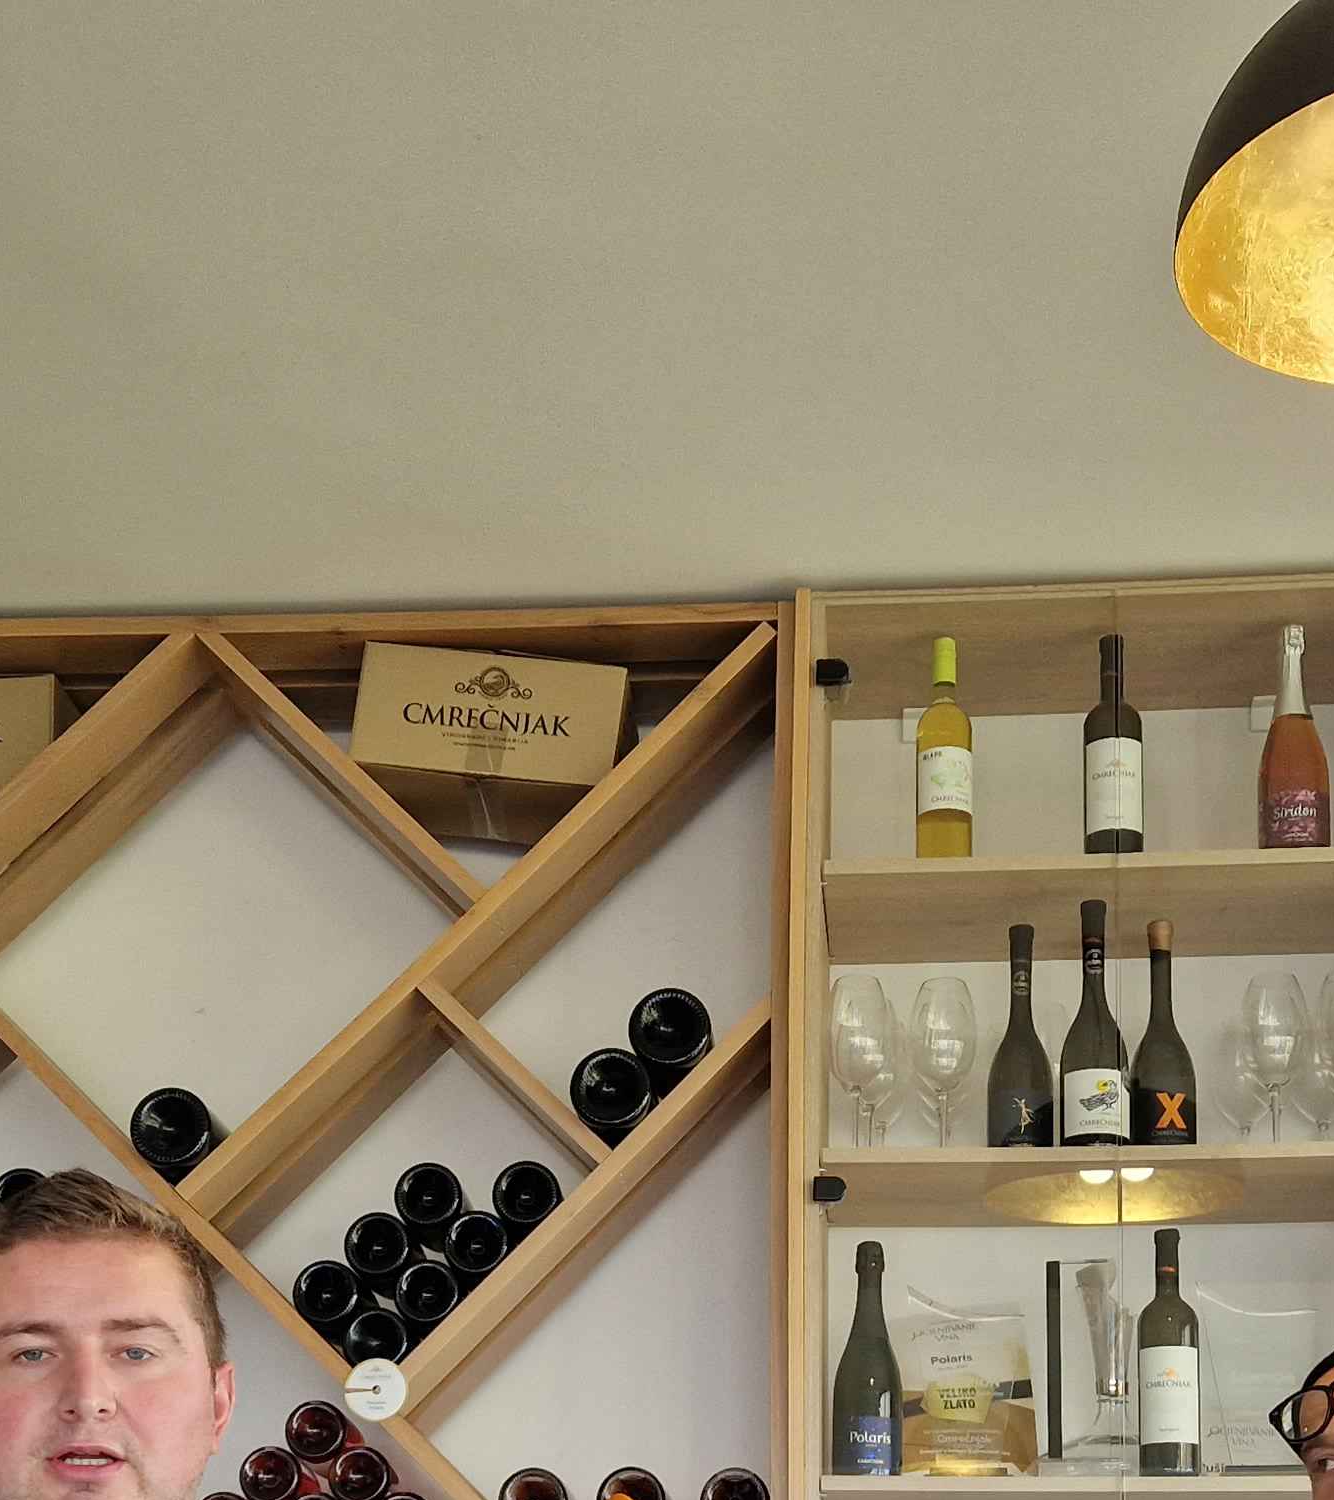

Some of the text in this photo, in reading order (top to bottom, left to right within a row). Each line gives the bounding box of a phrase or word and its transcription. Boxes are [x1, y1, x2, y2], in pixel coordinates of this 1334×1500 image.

[403, 702, 571, 737] CMREČNJAK
[1155, 1092, 1187, 1129] X
[930, 1352, 973, 1366] Polaris
[943, 1397, 976, 1410] ZLATO
[850, 1430, 892, 1445] Polaris
